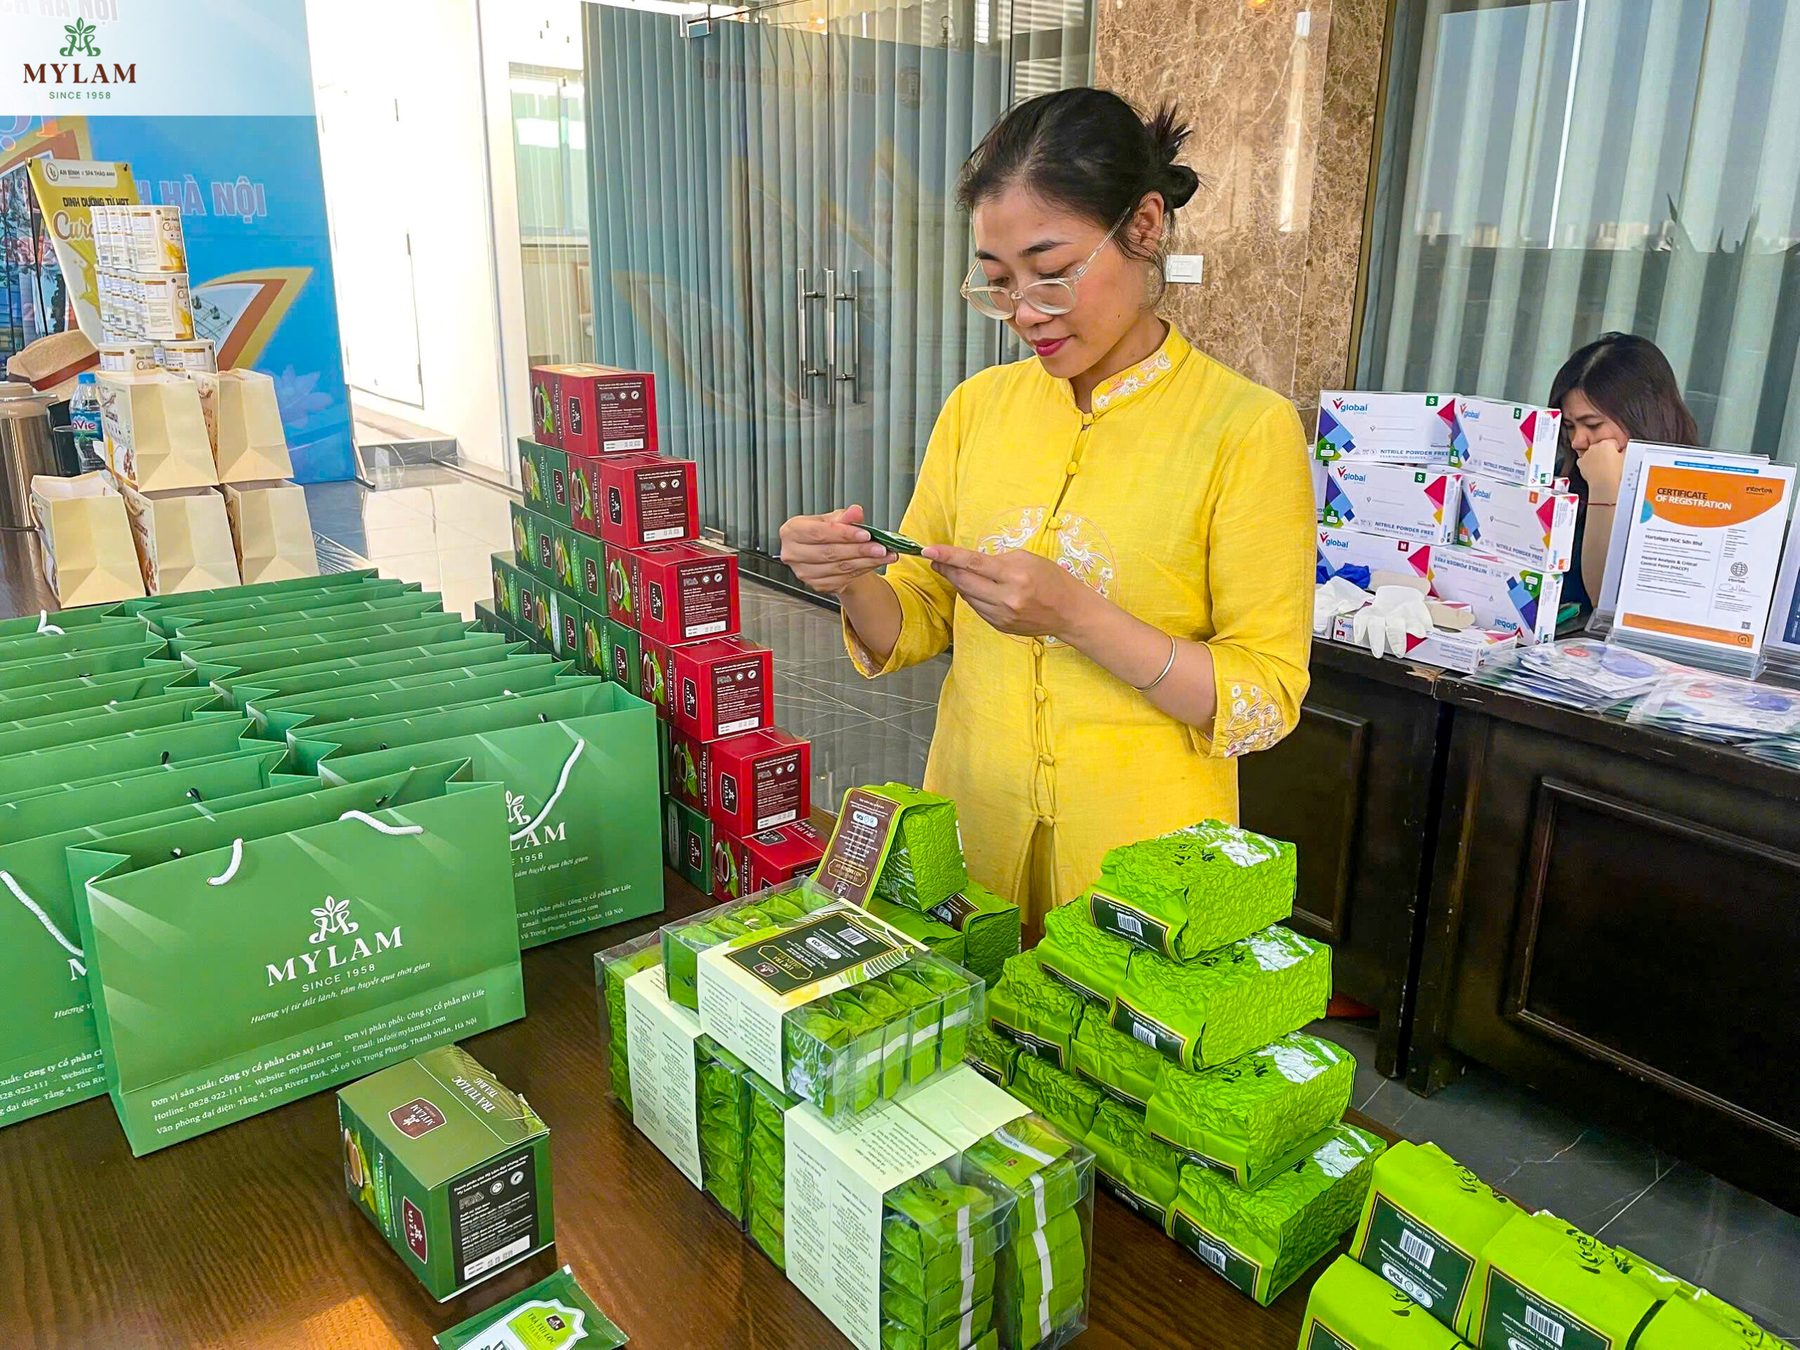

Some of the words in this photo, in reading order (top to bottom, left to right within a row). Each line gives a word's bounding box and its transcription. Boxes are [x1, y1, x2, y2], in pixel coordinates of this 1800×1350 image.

[159, 175, 207, 216] HÀ
[211, 175, 267, 223] NỘI
[1655, 494, 1668, 502] OF
[1668, 496, 1732, 510] REGISTRATION
[1656, 488, 1708, 500] CERTIFICATE
[520, 852, 544, 864] 1958
[266, 926, 404, 987] MYLAM
[250, 1010, 280, 1024] Hương
[281, 1006, 290, 1015] vị
[380, 974, 396, 984] qua
[396, 967, 412, 978] thời
[412, 961, 431, 974] gian
[302, 973, 342, 992] SINCE
[346, 963, 376, 980] 1958
[54, 1004, 85, 1018] Hương
[152, 1096, 168, 1108] Đơn
[169, 1092, 180, 1102] vị
[180, 1086, 194, 1098] sản
[196, 1080, 218, 1092] xuất:
[218, 1072, 240, 1084] Công
[242, 1068, 250, 1078] ty
[251, 1060, 262, 1073] Cổ
[264, 1056, 284, 1070] phần
[286, 1050, 301, 1060] Chè
[302, 1044, 316, 1056] Mỹ
[316, 1040, 334, 1051] Lâm
[344, 1030, 359, 1042] Đơn
[360, 1028, 367, 1036] vị
[369, 1022, 387, 1034] phân
[406, 1010, 425, 1020] Công
[425, 1006, 433, 1015] ty
[443, 996, 461, 1010] phần
[462, 994, 472, 1002] BV
[472, 988, 486, 998] Life
[24, 1068, 46, 1080] Công
[47, 1064, 57, 1073] ty
[58, 1057, 69, 1068] Cổ
[70, 1052, 92, 1066] phần
[61, 1066, 94, 1082] Website:
[154, 1104, 187, 1122] Hotline:
[188, 1085, 243, 1110] 0828.922.111
[254, 1070, 287, 1086] Website:
[288, 1051, 342, 1076] mylamtea.com
[352, 1039, 374, 1052] Email:
[156, 1124, 174, 1135] Văn
[175, 1116, 200, 1132] phòng
[202, 1108, 216, 1120] đại
[237, 1094, 258, 1106] Tầng
[269, 1086, 283, 1096] Tòa
[284, 1077, 309, 1091] Rivera
[310, 1072, 329, 1083] Park,
[330, 1064, 340, 1074] số
[340, 1062, 350, 1070] 69
[362, 1050, 384, 1064] Trọng
[384, 1042, 409, 1056] Phụng,
[410, 1032, 432, 1046] Thanh
[433, 1026, 454, 1038] Xuân,
[454, 1022, 464, 1031] Hà
[465, 1017, 477, 1027] Nội
[6, 1104, 20, 1113] đại
[75, 1080, 91, 1090] Tòa
